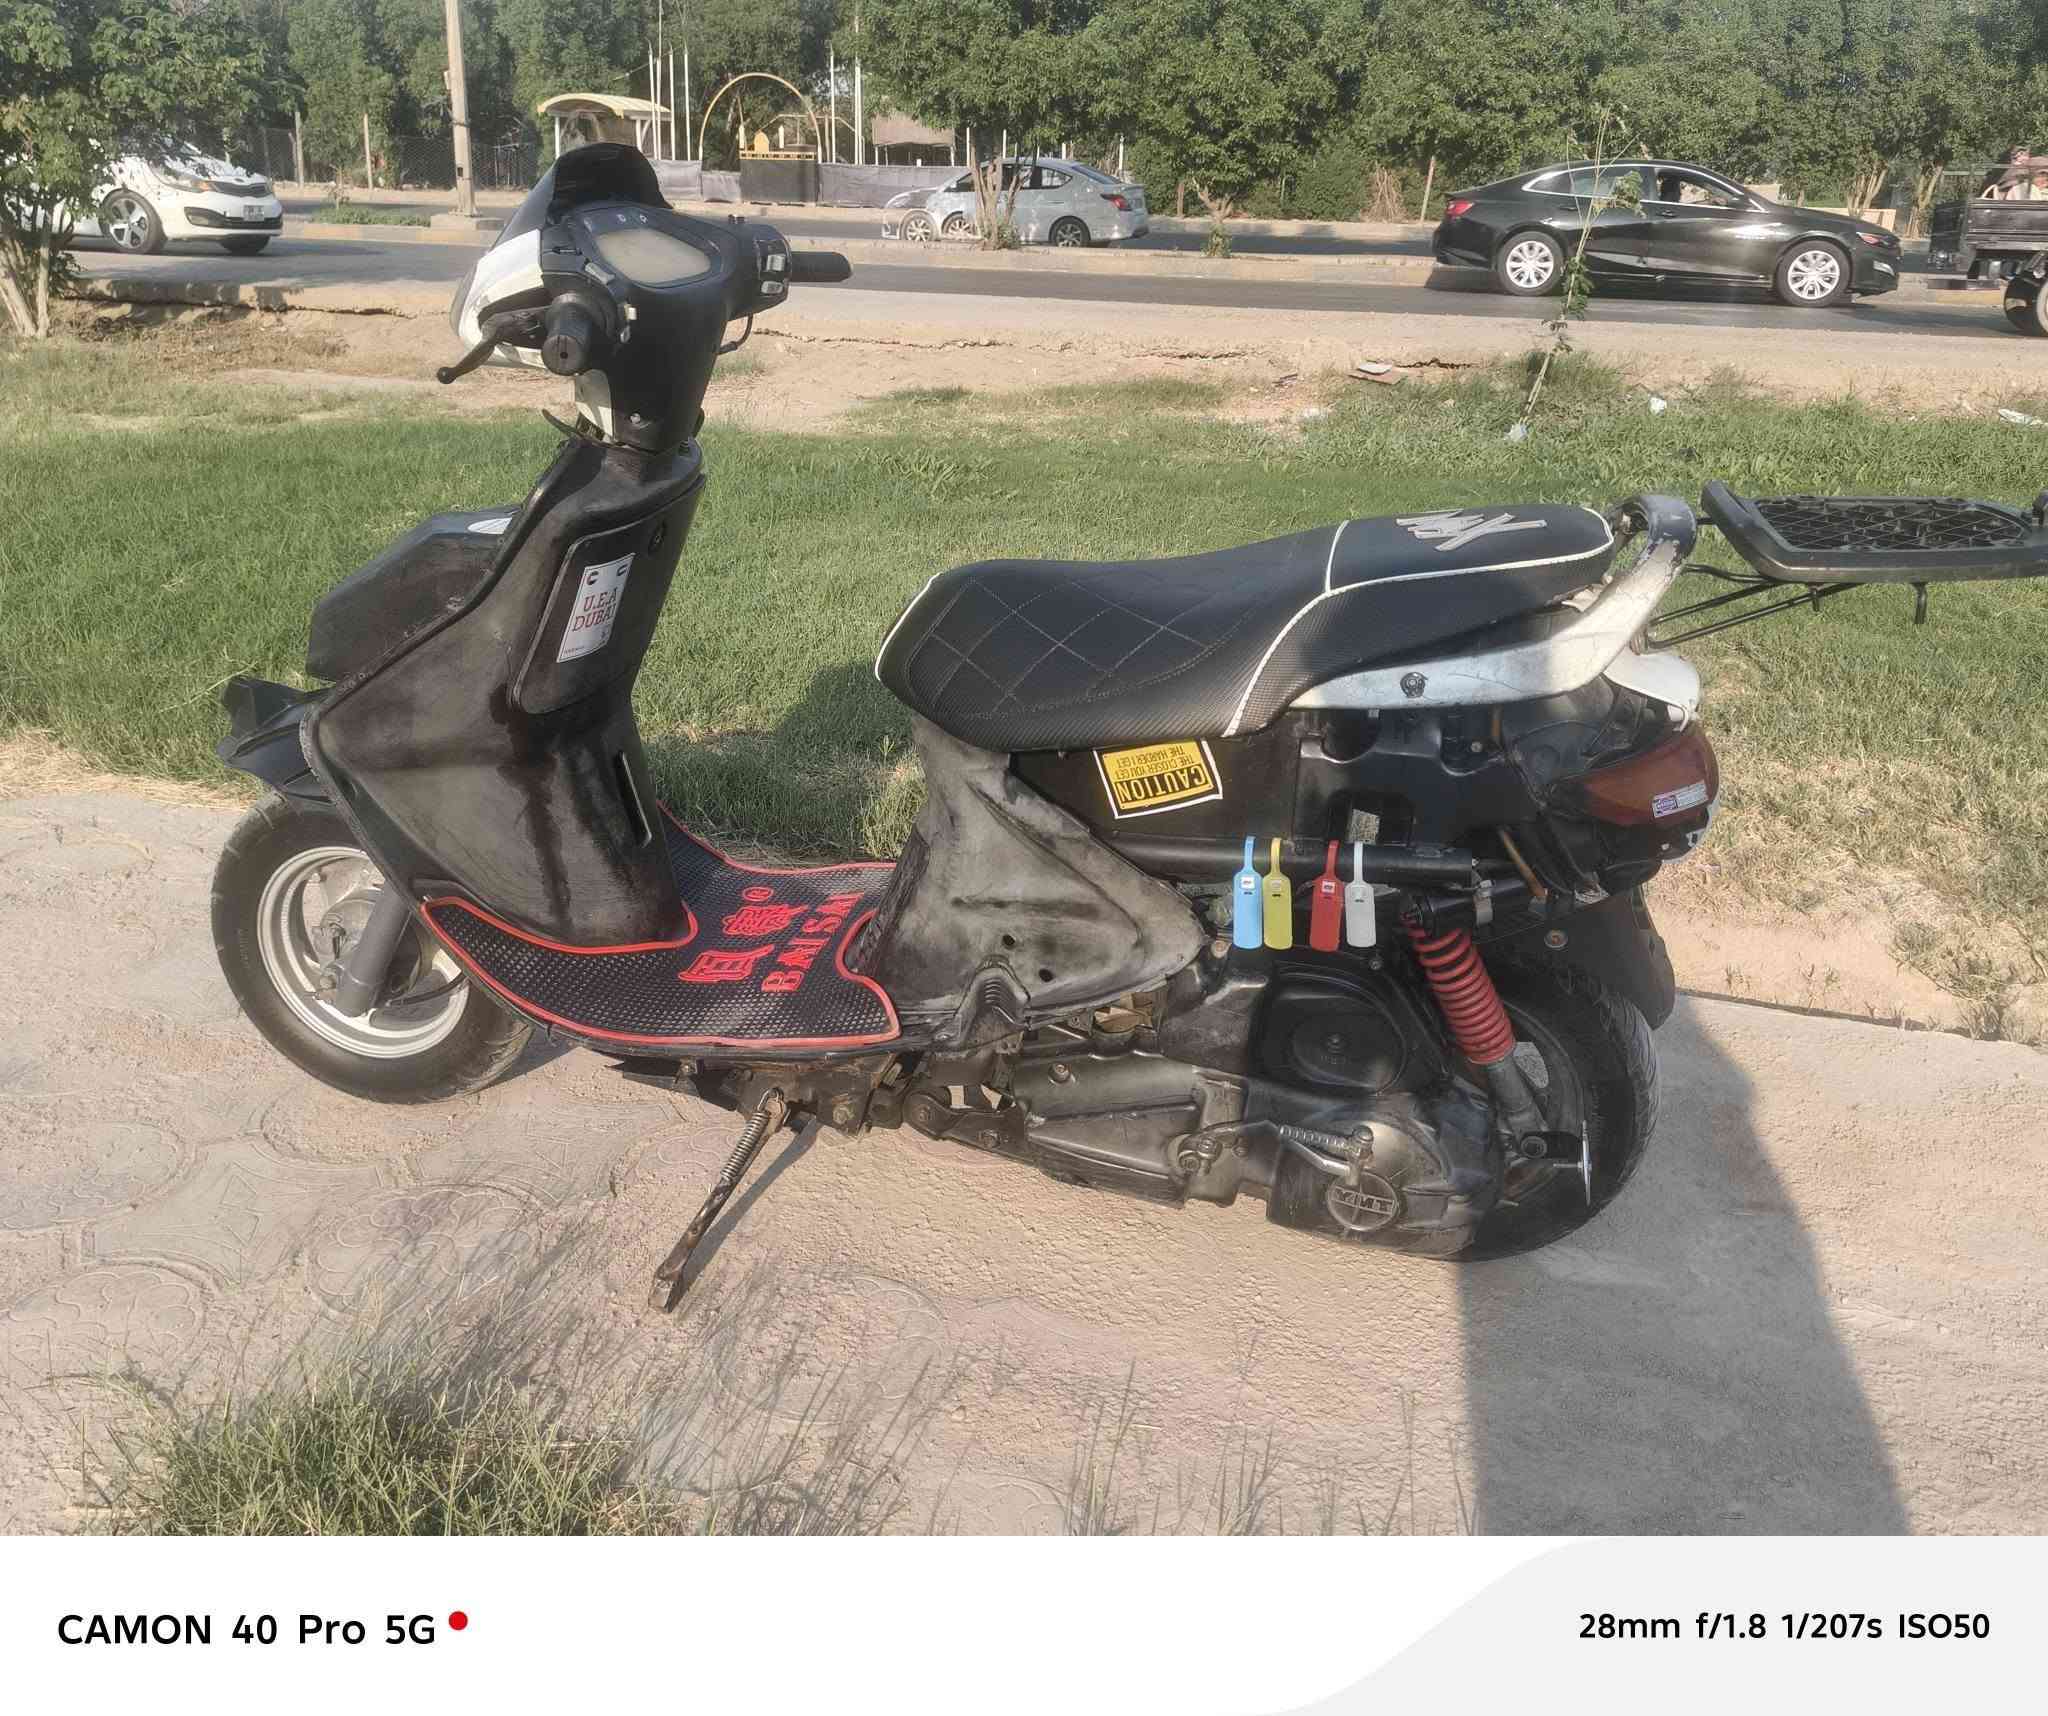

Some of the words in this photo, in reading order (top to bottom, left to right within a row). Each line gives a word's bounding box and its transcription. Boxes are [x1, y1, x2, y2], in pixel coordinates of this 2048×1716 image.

[572, 603, 618, 632] DUBAI
[1136, 750, 1168, 764] HARDER
[1169, 745, 1184, 757] THE
[1116, 757, 1131, 768] GET
[1147, 759, 1178, 774] CLOSER
[1179, 754, 1194, 767] THE
[1114, 768, 1129, 779] GET
[1129, 766, 1146, 777] YOU
[1115, 764, 1206, 802] CAUTION
[761, 891, 865, 993] BAISAI
